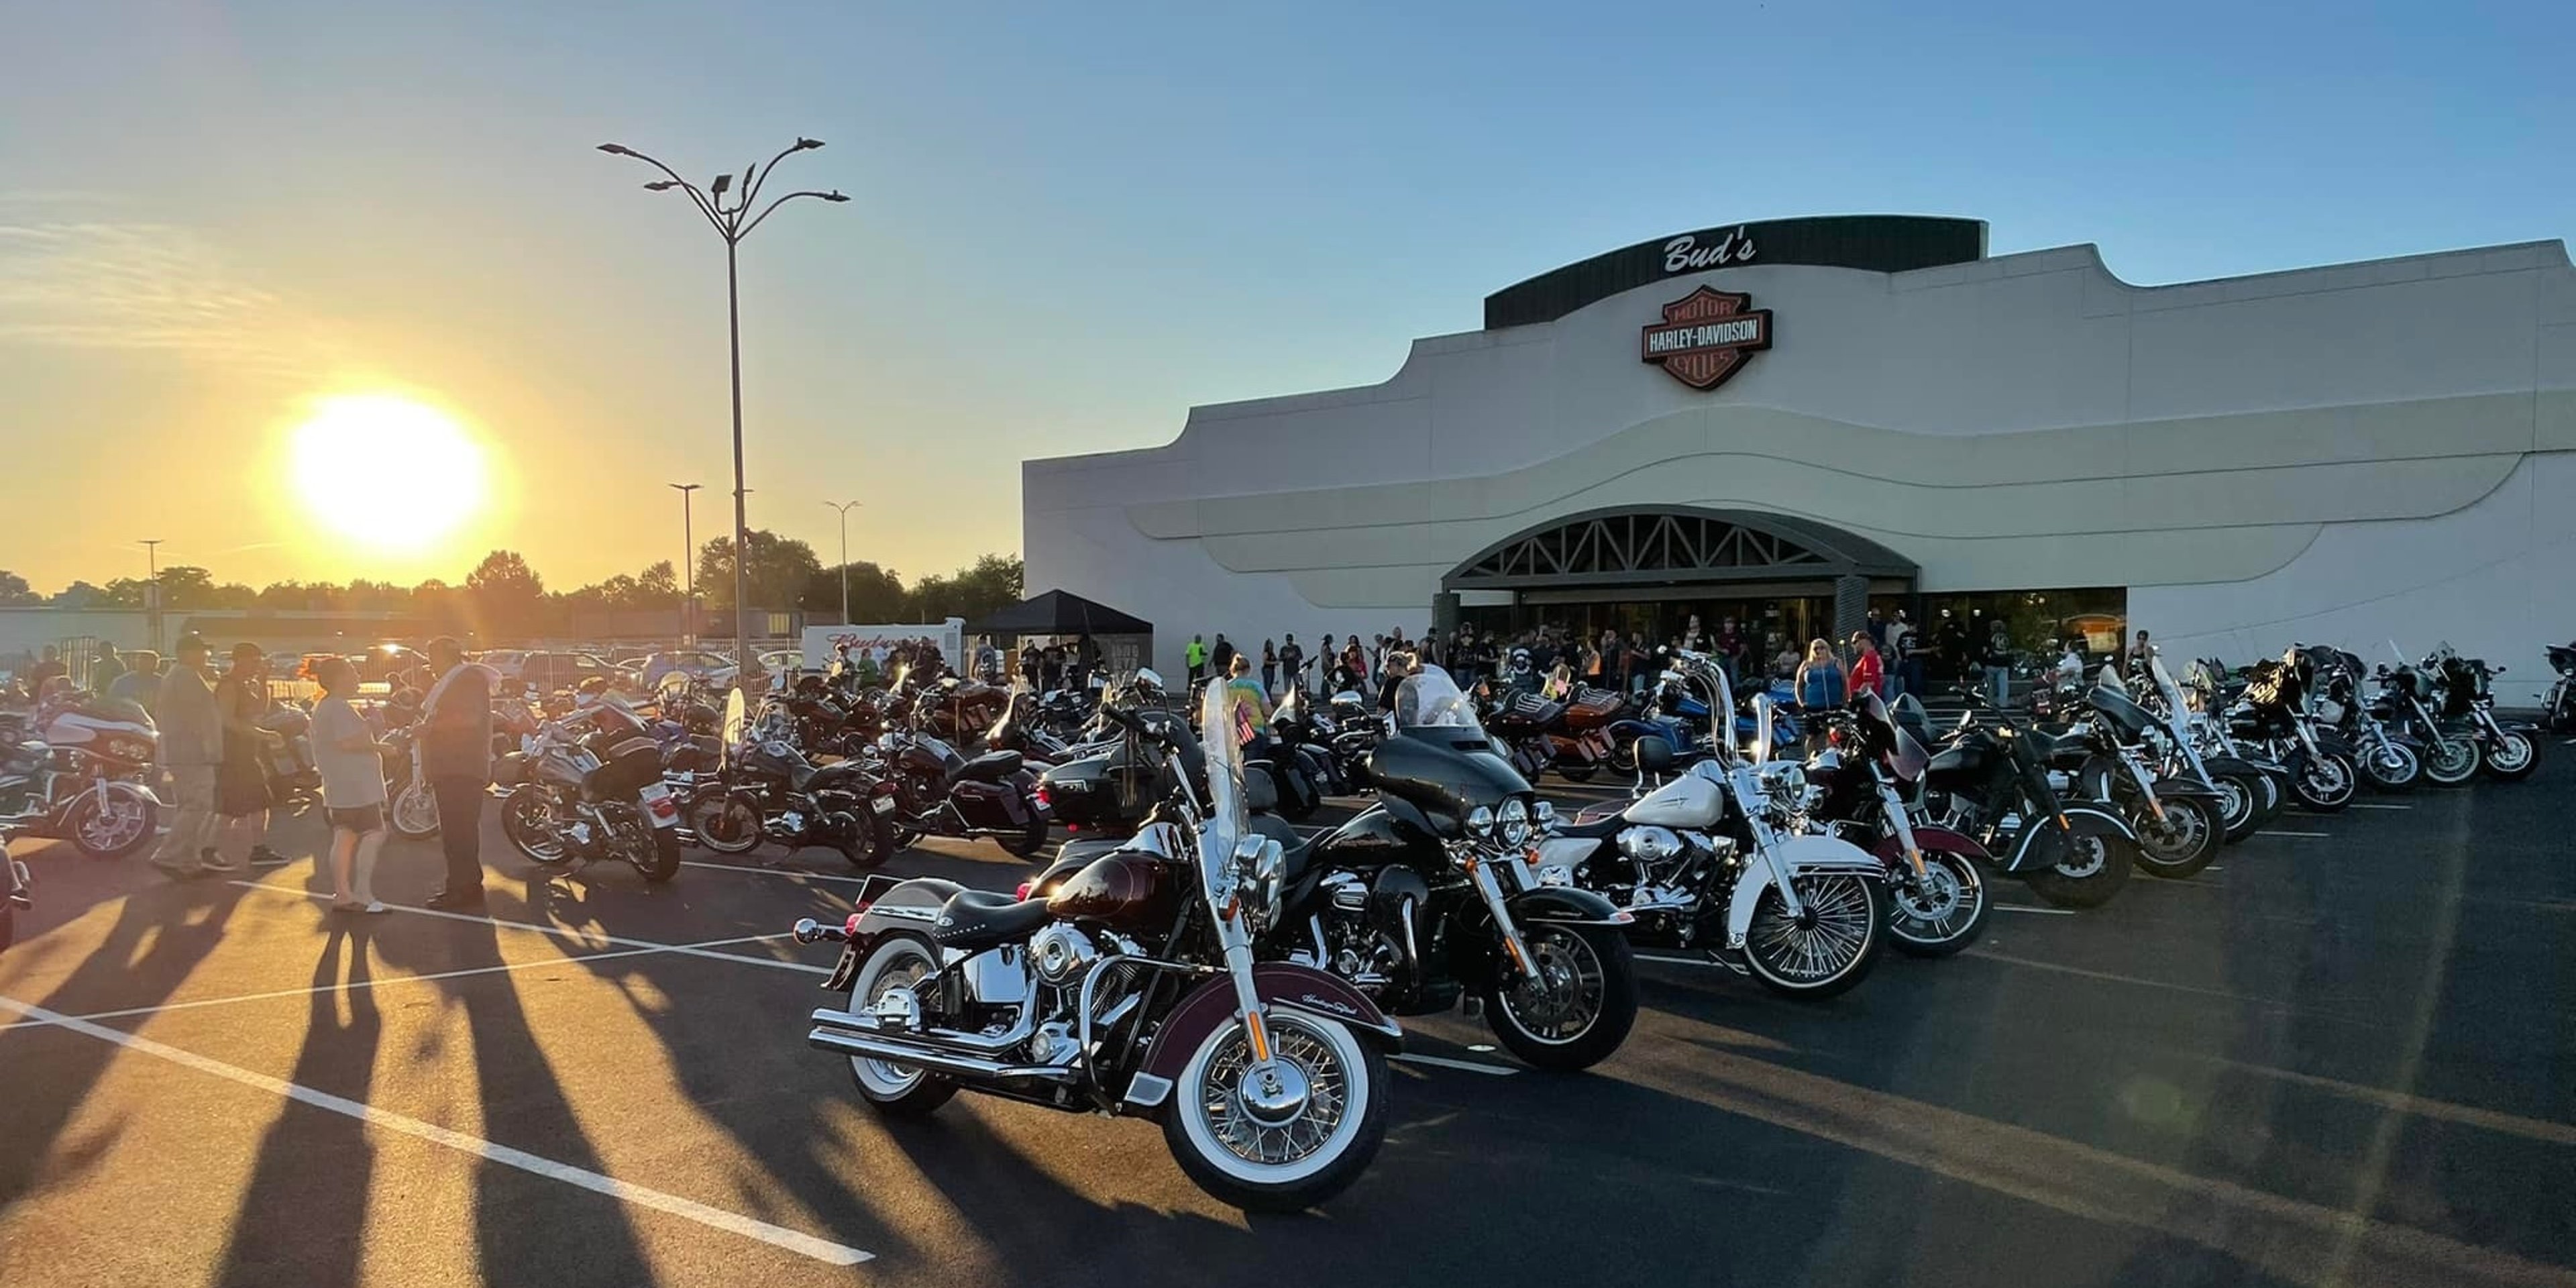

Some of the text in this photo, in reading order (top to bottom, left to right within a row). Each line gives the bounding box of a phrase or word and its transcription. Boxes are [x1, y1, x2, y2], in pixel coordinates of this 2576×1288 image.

[1664, 225, 1757, 272] Bud's
[1674, 296, 1732, 321] MOTOR
[1650, 319, 1758, 352] HARLEY-DAVIDSON
[1674, 352, 1731, 380] CYCLES
